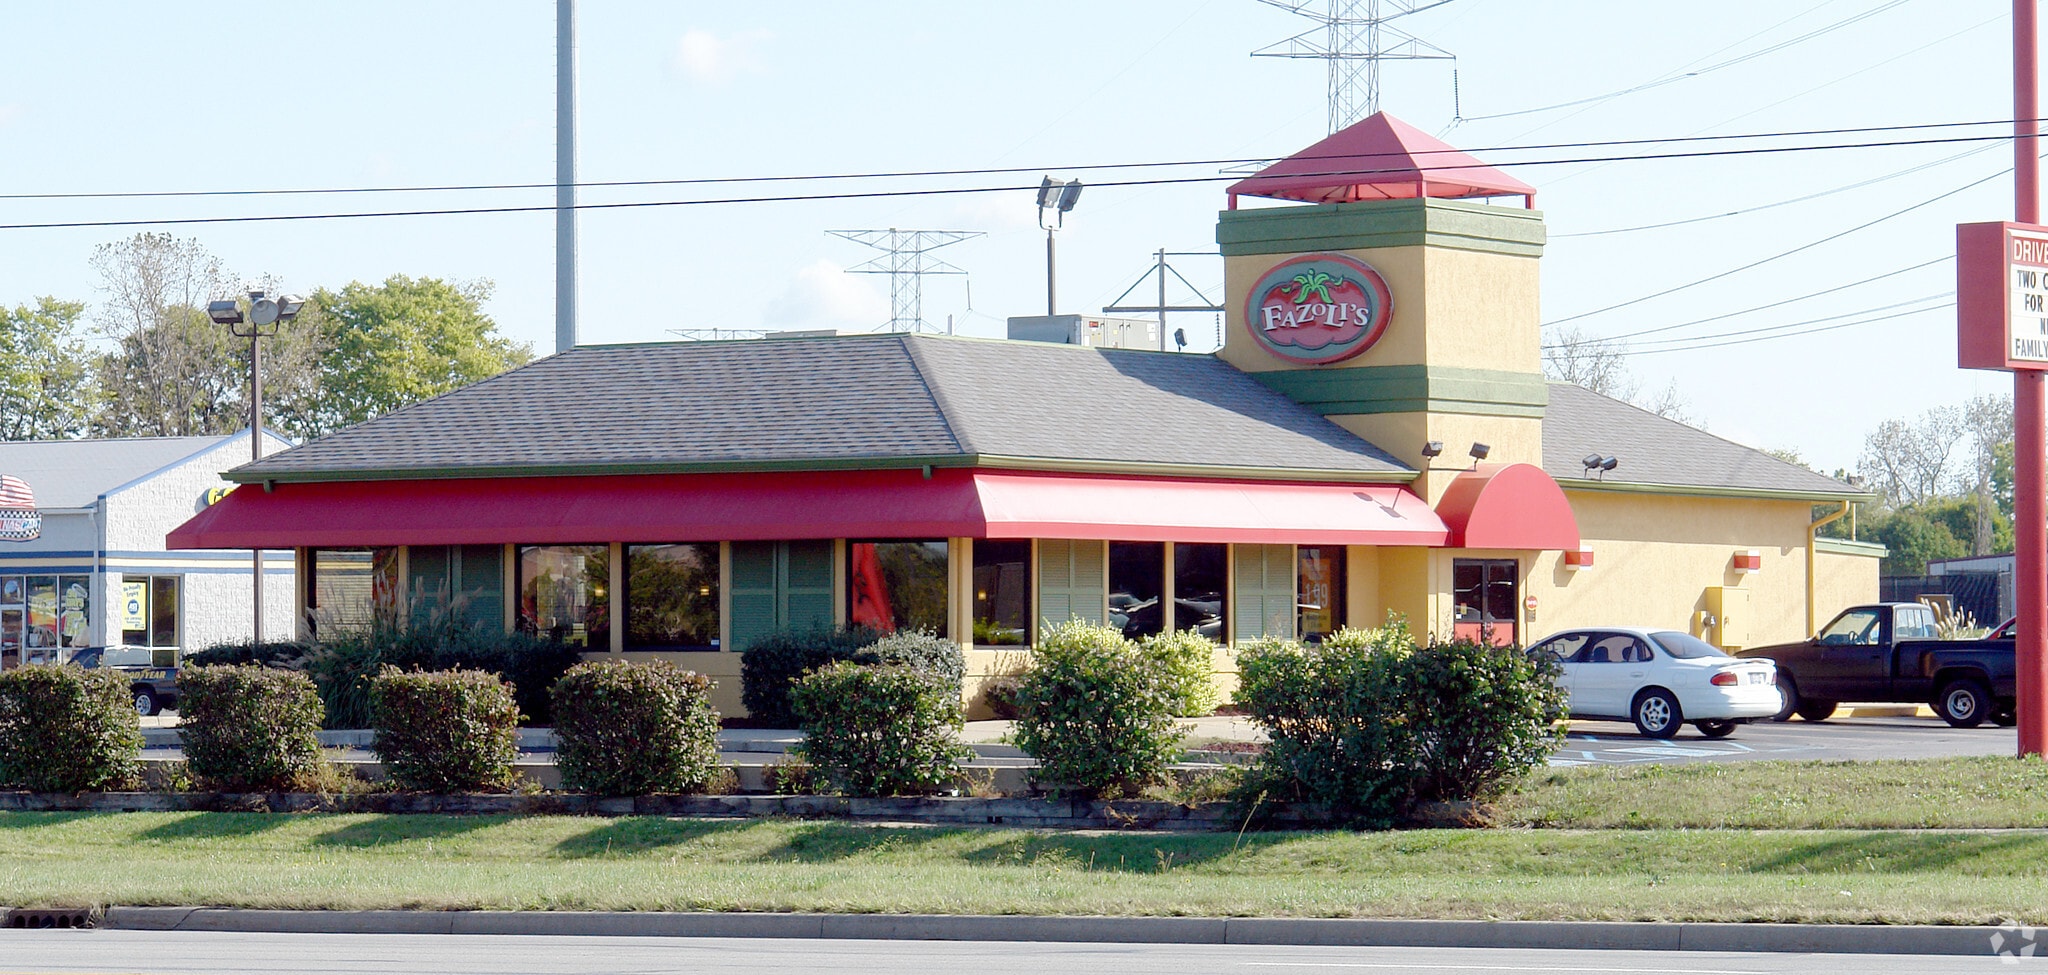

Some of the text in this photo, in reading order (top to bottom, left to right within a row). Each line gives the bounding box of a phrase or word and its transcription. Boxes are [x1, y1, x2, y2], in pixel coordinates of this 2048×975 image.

[2013, 238, 2048, 264] DRIVE
[2017, 270, 2036, 289] TWO
[2025, 293, 2043, 312] FOR
[1262, 302, 1369, 331] FAZOLI'S
[2015, 338, 2048, 358] FAMILY
